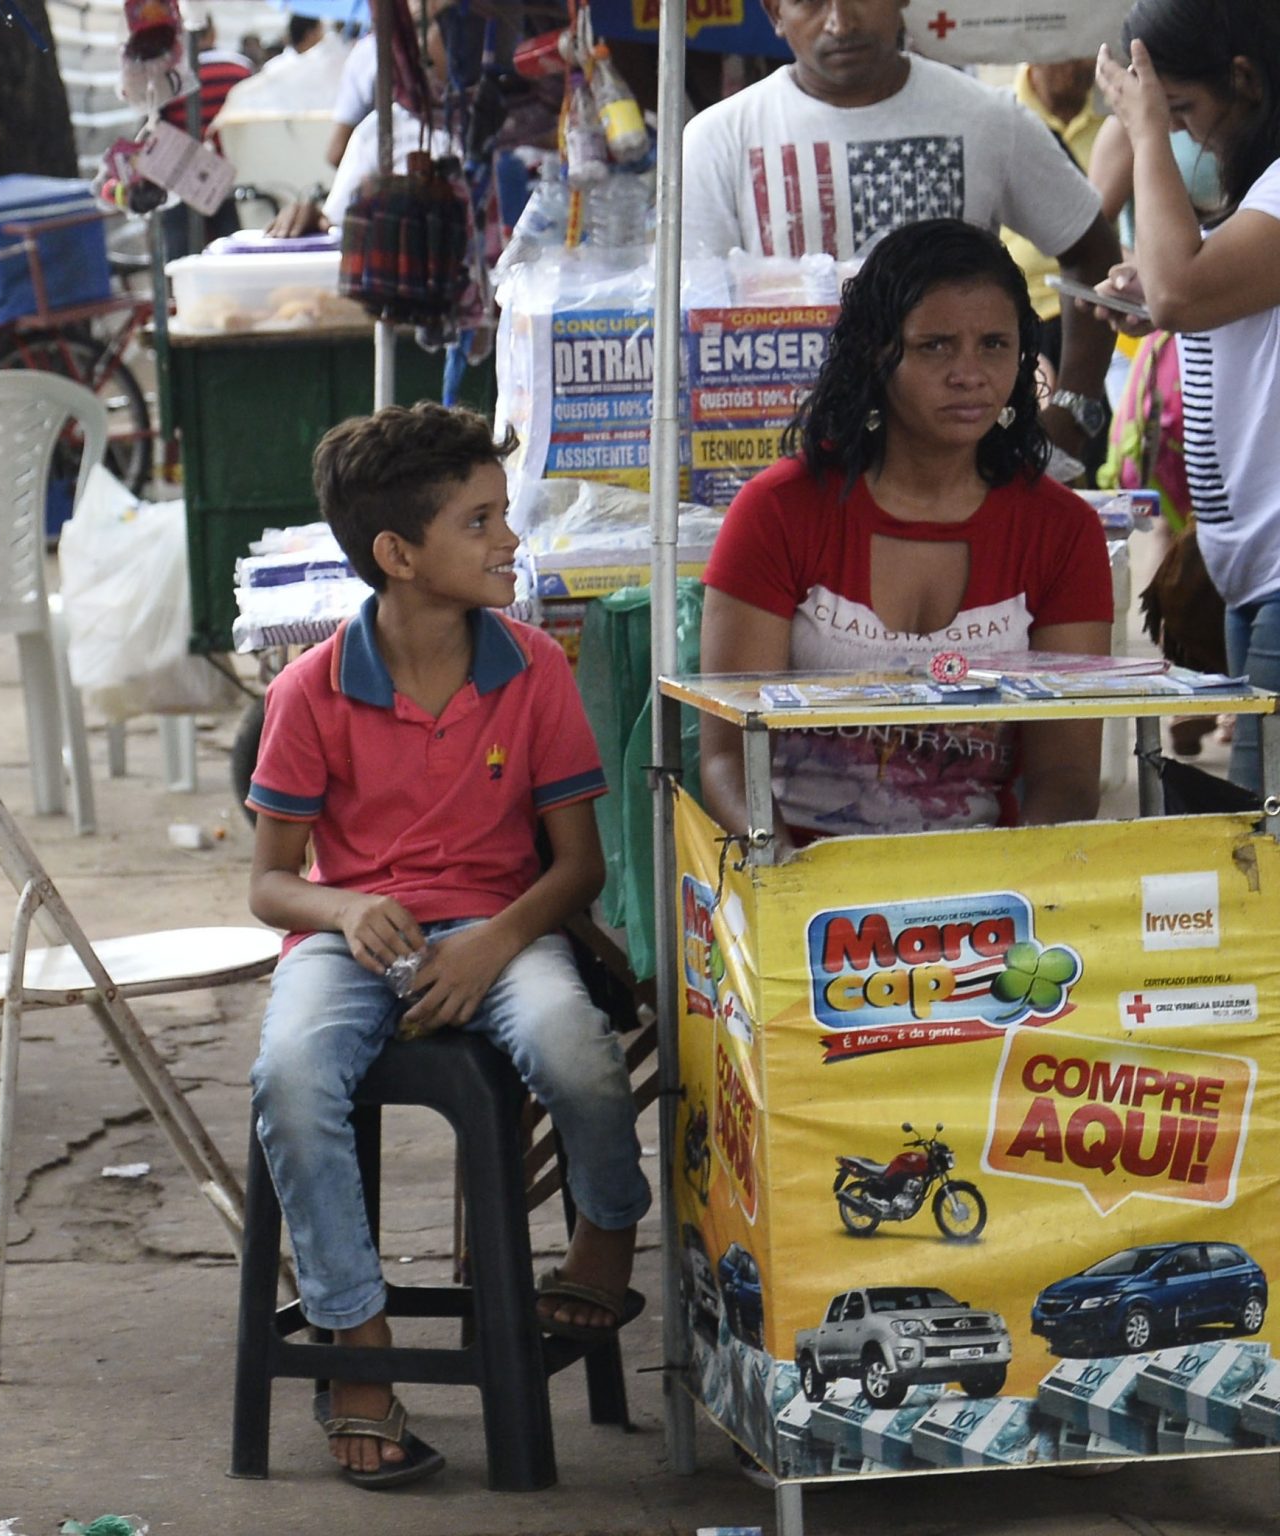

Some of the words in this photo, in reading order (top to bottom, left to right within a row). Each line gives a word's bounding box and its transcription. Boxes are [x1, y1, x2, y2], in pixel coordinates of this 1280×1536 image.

[731, 308, 829, 327] CONCURSO
[556, 445, 634, 469] ASSISTENTE
[757, 438, 773, 458] DE
[945, 615, 1011, 642] GRAY
[1146, 908, 1213, 932] Invest
[822, 913, 1015, 973] Mara
[825, 965, 956, 1019] cap
[843, 1034, 851, 1048] É
[909, 1027, 924, 1038] da
[1022, 1054, 1225, 1118] COMPRE
[1005, 1097, 1219, 1185] AQUI!
